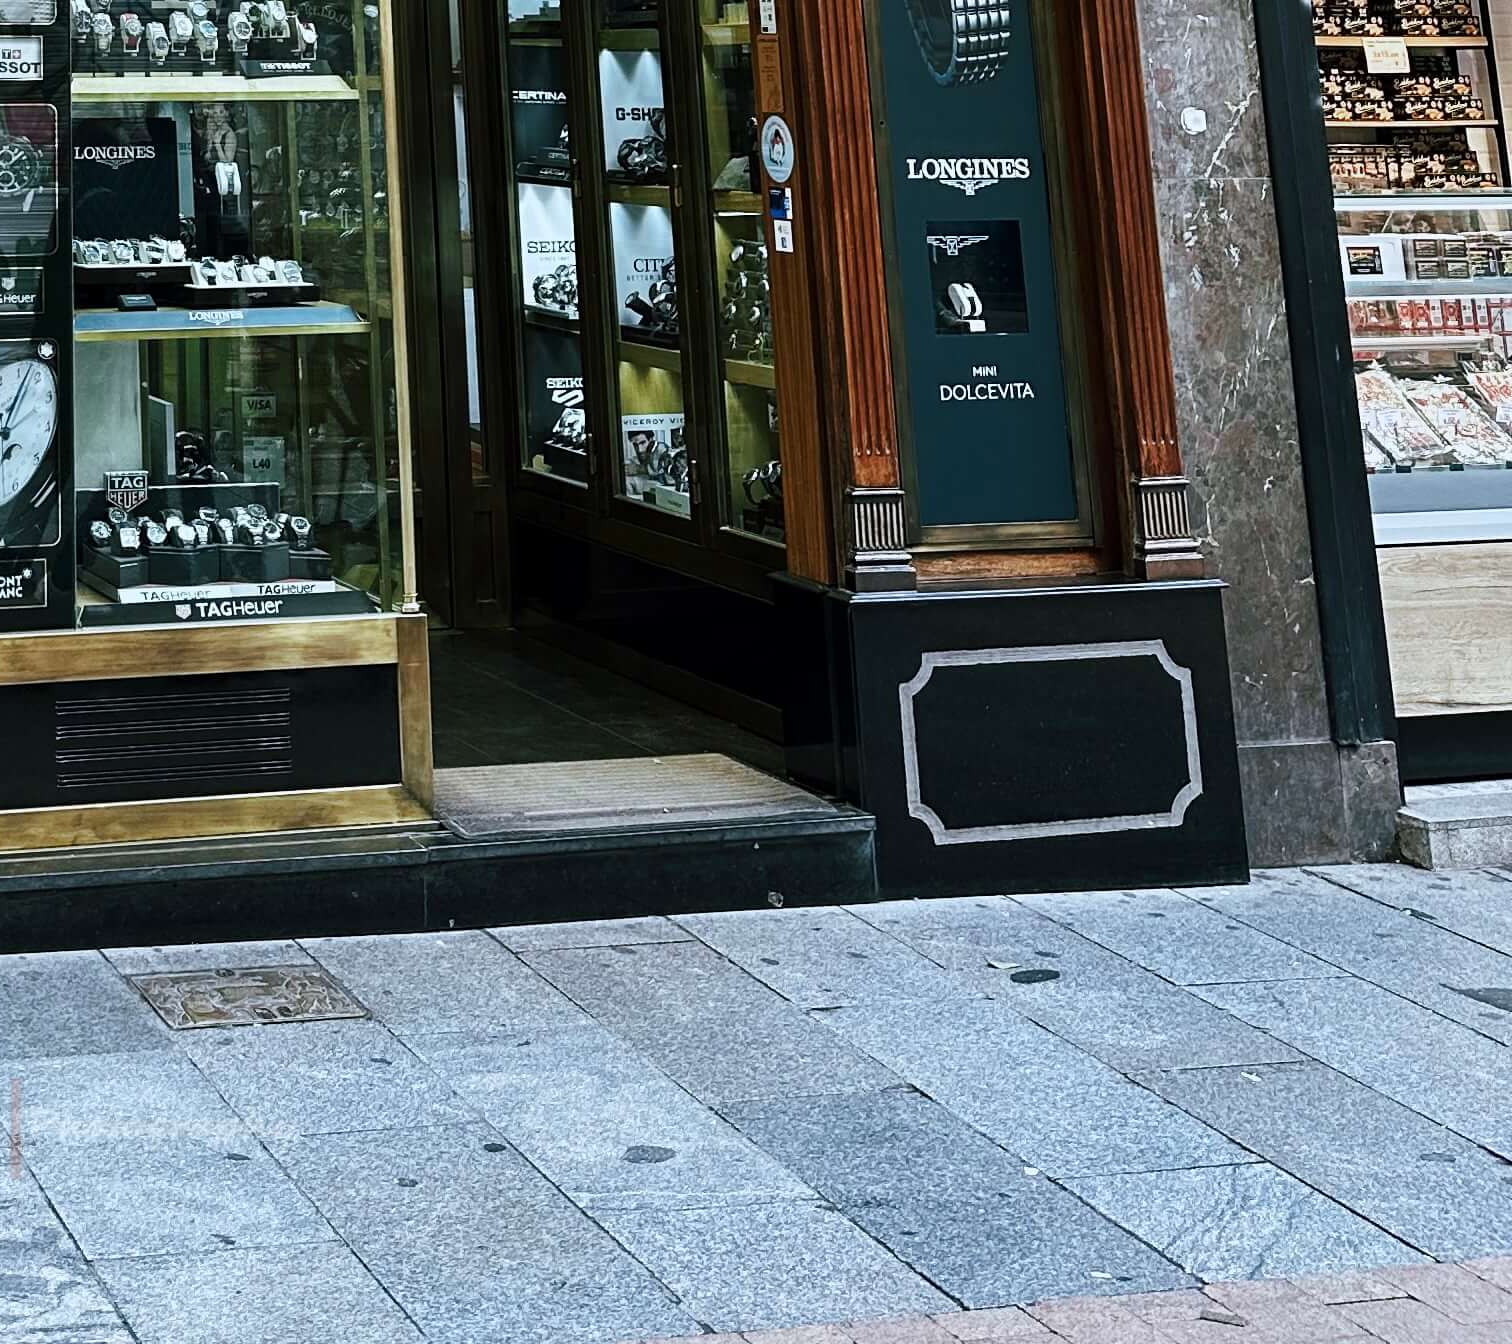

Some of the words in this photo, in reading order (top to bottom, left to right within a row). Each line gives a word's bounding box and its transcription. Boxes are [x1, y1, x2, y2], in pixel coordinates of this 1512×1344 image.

[73, 146, 156, 161] LONGINES
[906, 158, 1030, 180] LONGINES
[972, 365, 997, 377] MINI
[939, 382, 1035, 402] DOLCEVITA
[247, 399, 272, 411] VISA
[111, 476, 144, 488] TAG
[110, 490, 145, 508] HEUER
[256, 583, 316, 595] TAGHeuer
[196, 600, 283, 617] TAGHeuer
